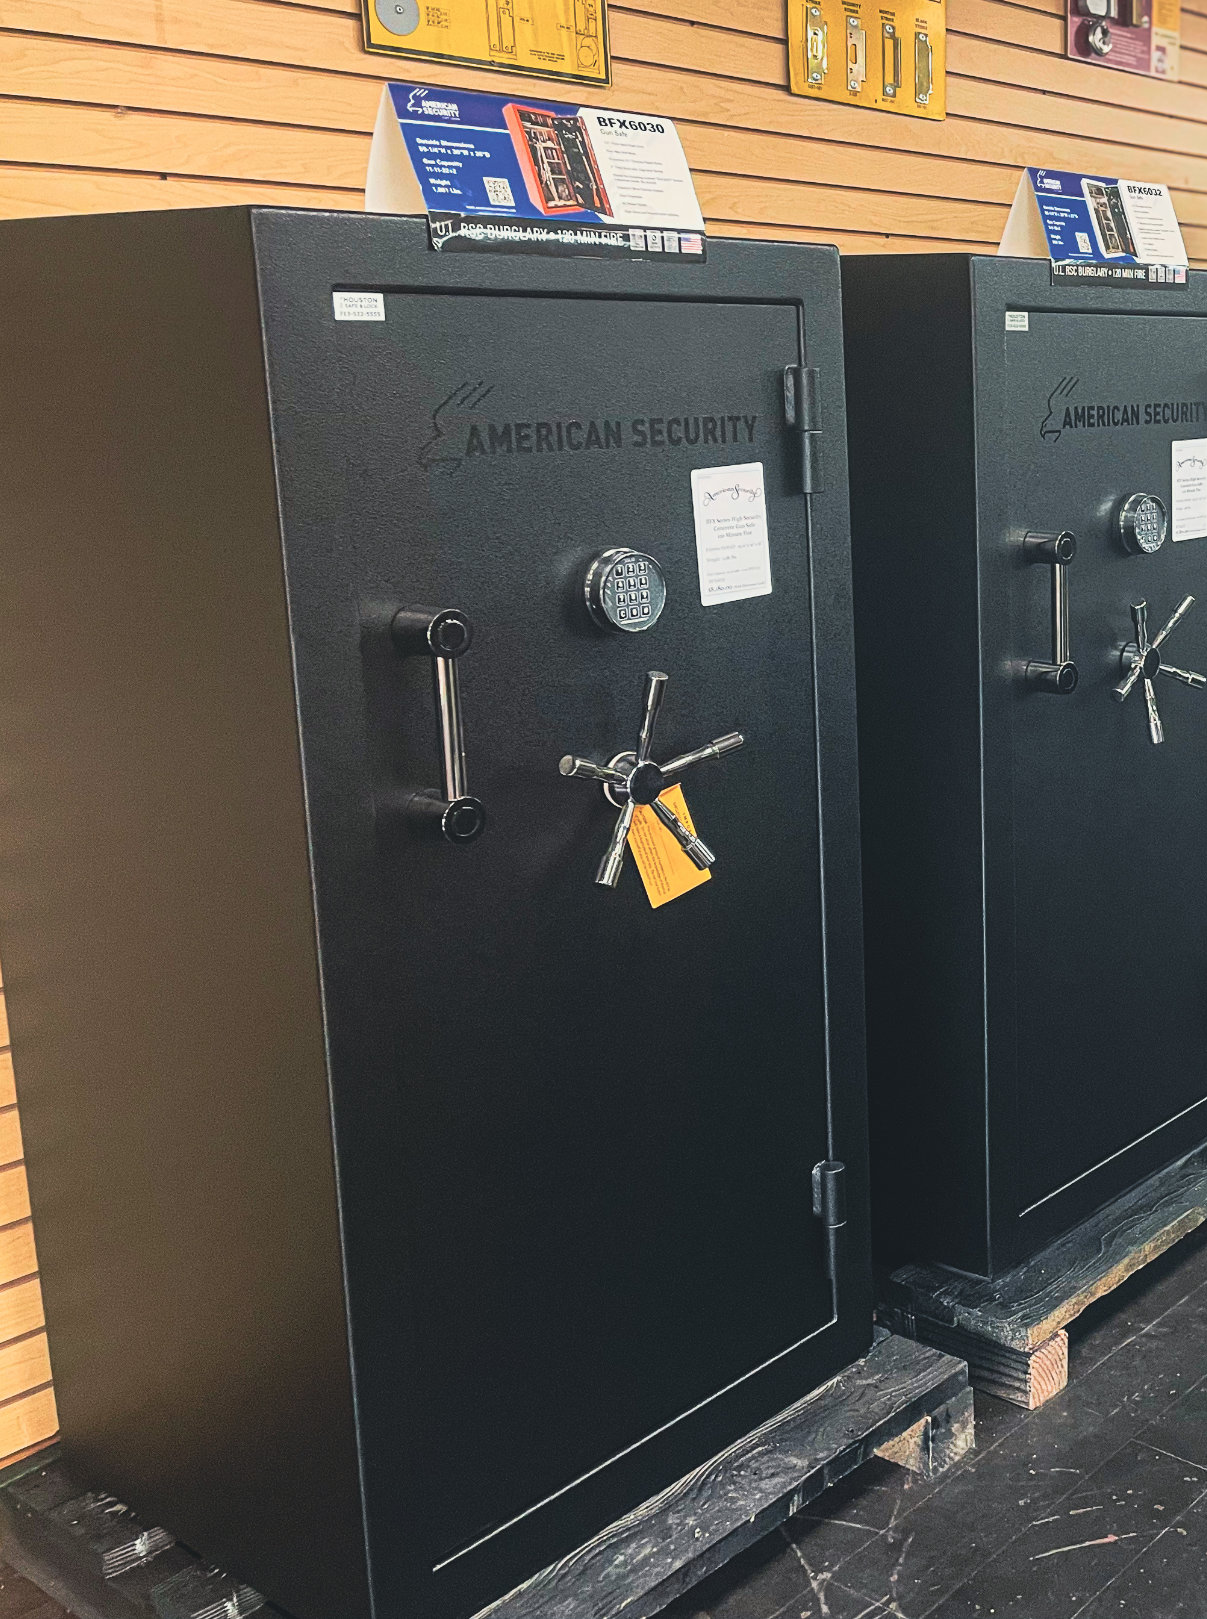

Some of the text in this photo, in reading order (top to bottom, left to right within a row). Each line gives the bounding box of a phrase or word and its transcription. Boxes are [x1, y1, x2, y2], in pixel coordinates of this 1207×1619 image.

[422, 107, 460, 118] SECURITY
[596, 116, 665, 134] BFX6030
[1065, 266, 1078, 276] RSC
[1078, 266, 1109, 277] BURGLARY
[1134, 269, 1146, 280] FIRE
[1062, 404, 1140, 429] AMERICAN
[465, 415, 758, 457] AMERICAN SECURITY
